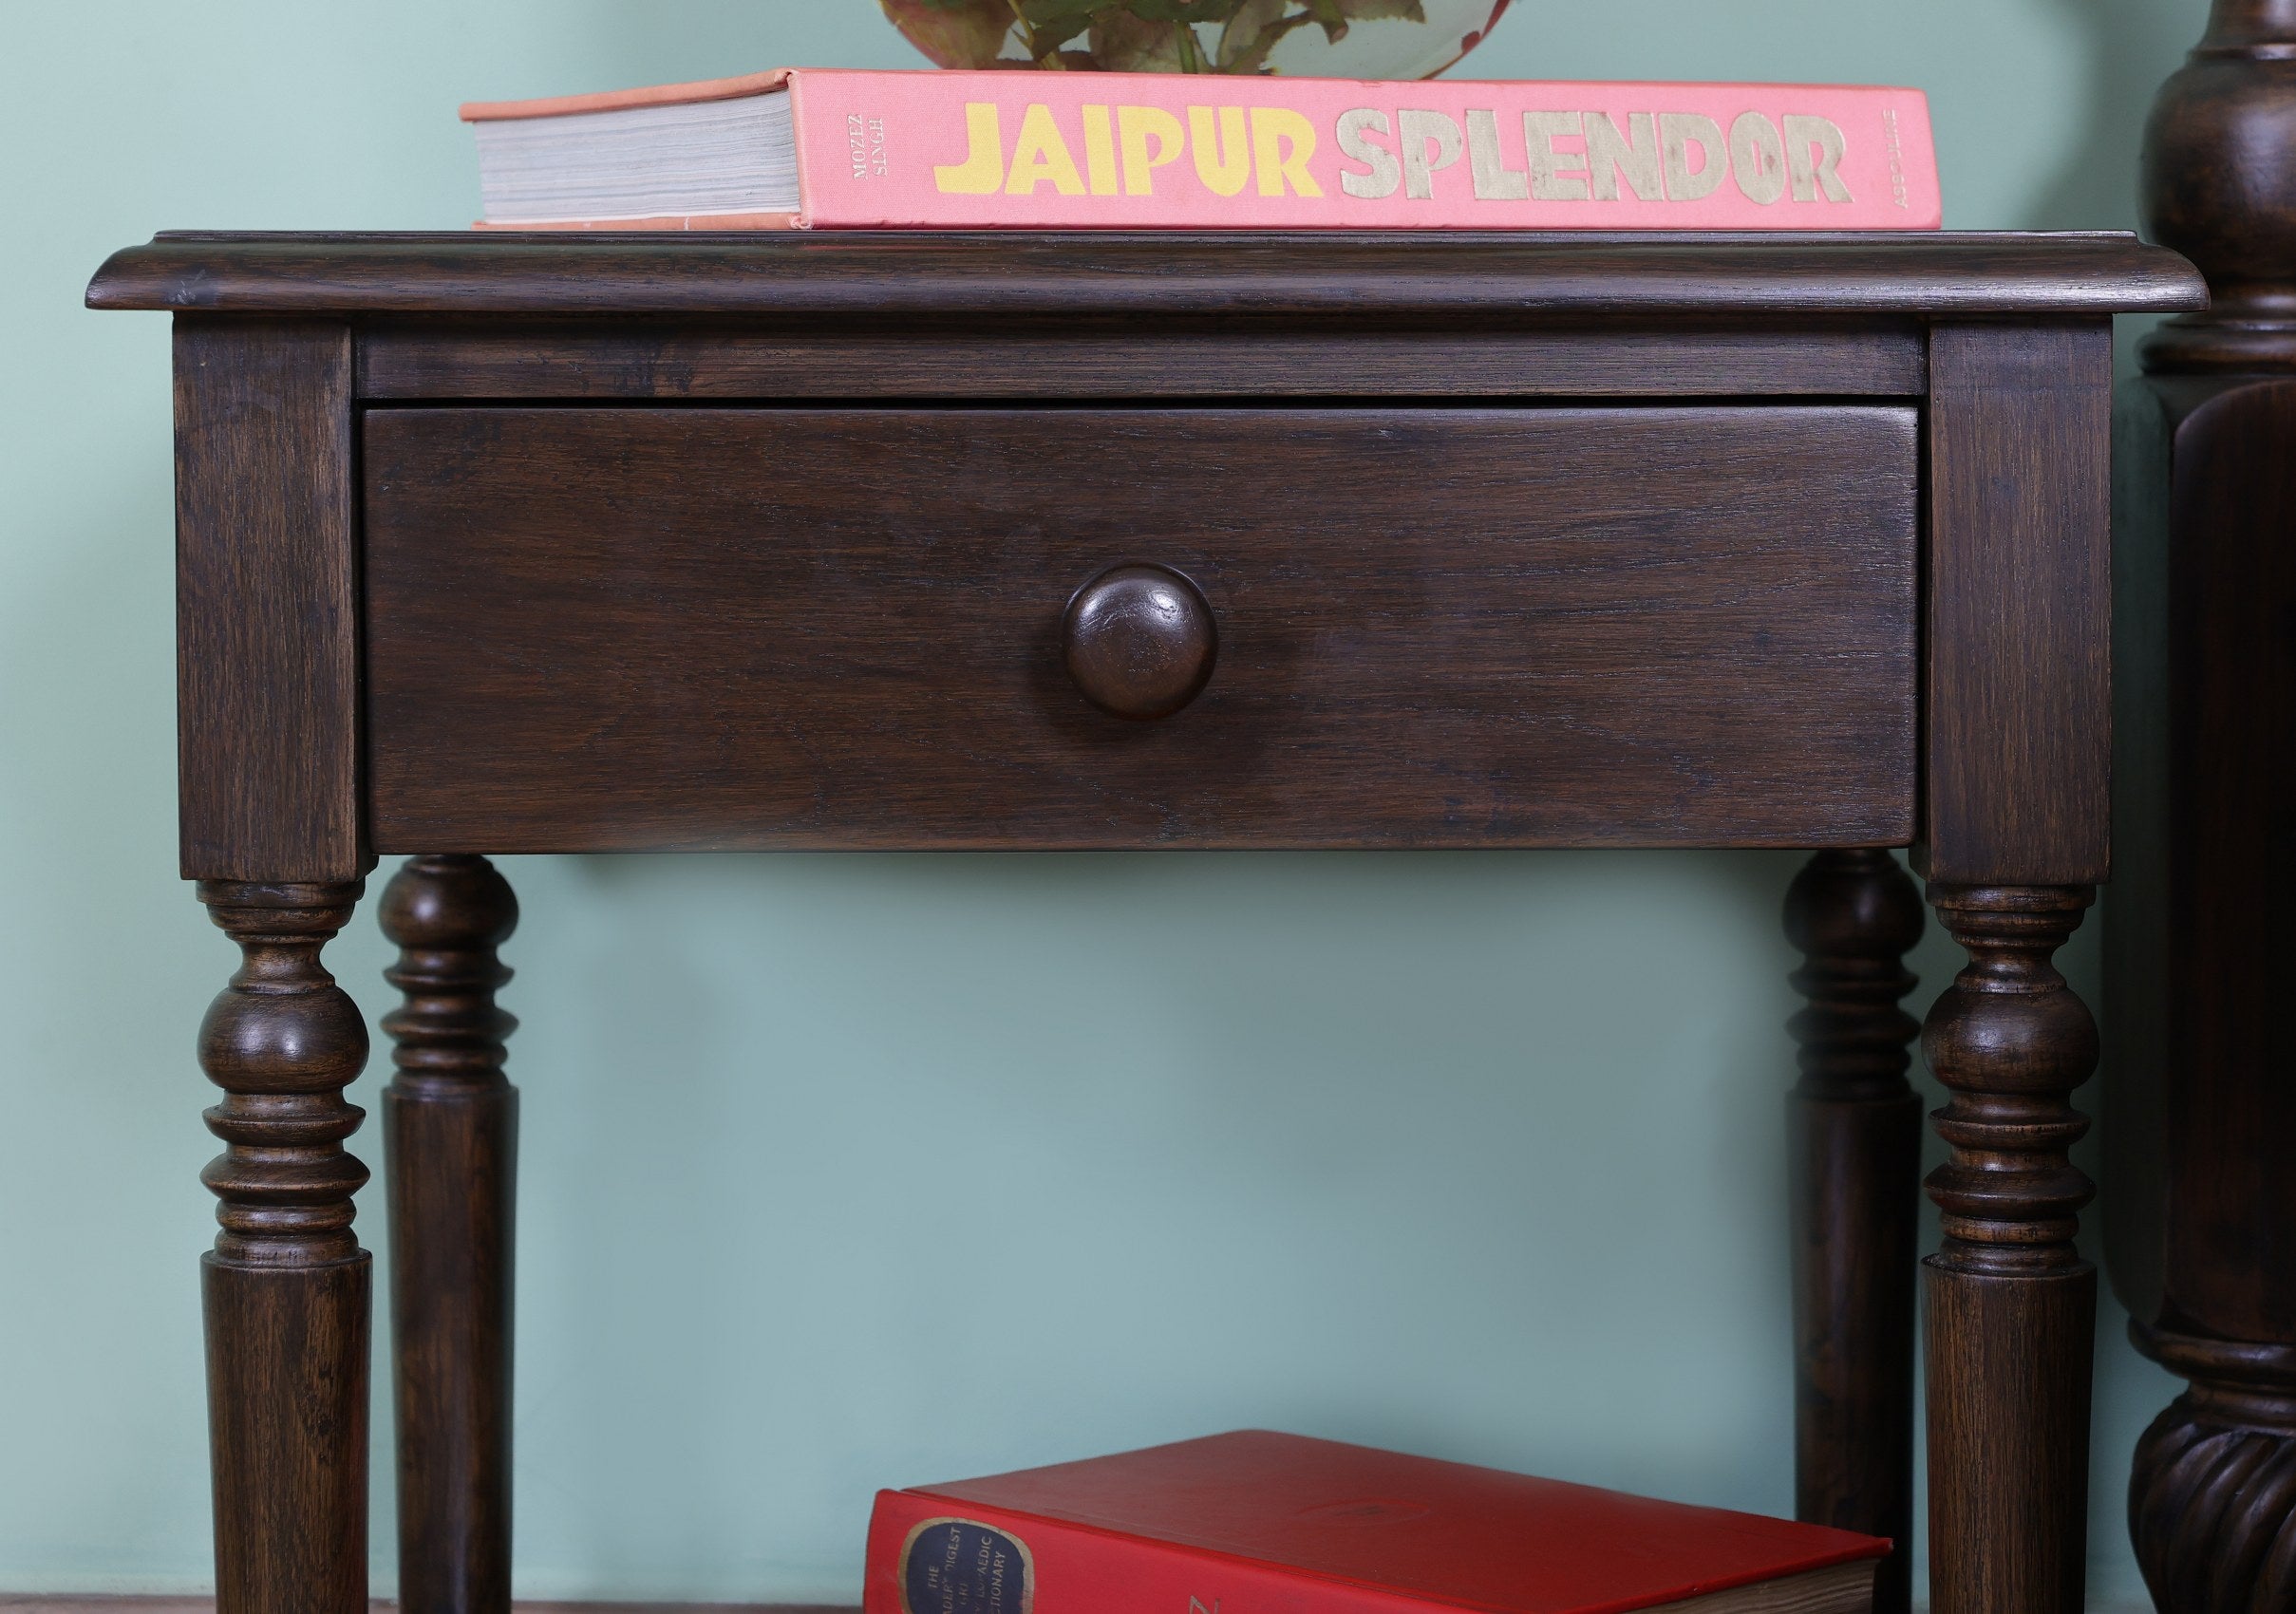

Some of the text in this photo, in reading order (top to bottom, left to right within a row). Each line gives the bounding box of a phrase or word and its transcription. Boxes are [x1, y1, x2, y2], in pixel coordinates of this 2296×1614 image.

[868, 118, 888, 177] SINGH
[932, 103, 1854, 205] JAIPUR SPLENDOR
[928, 1565, 939, 1588] THE
